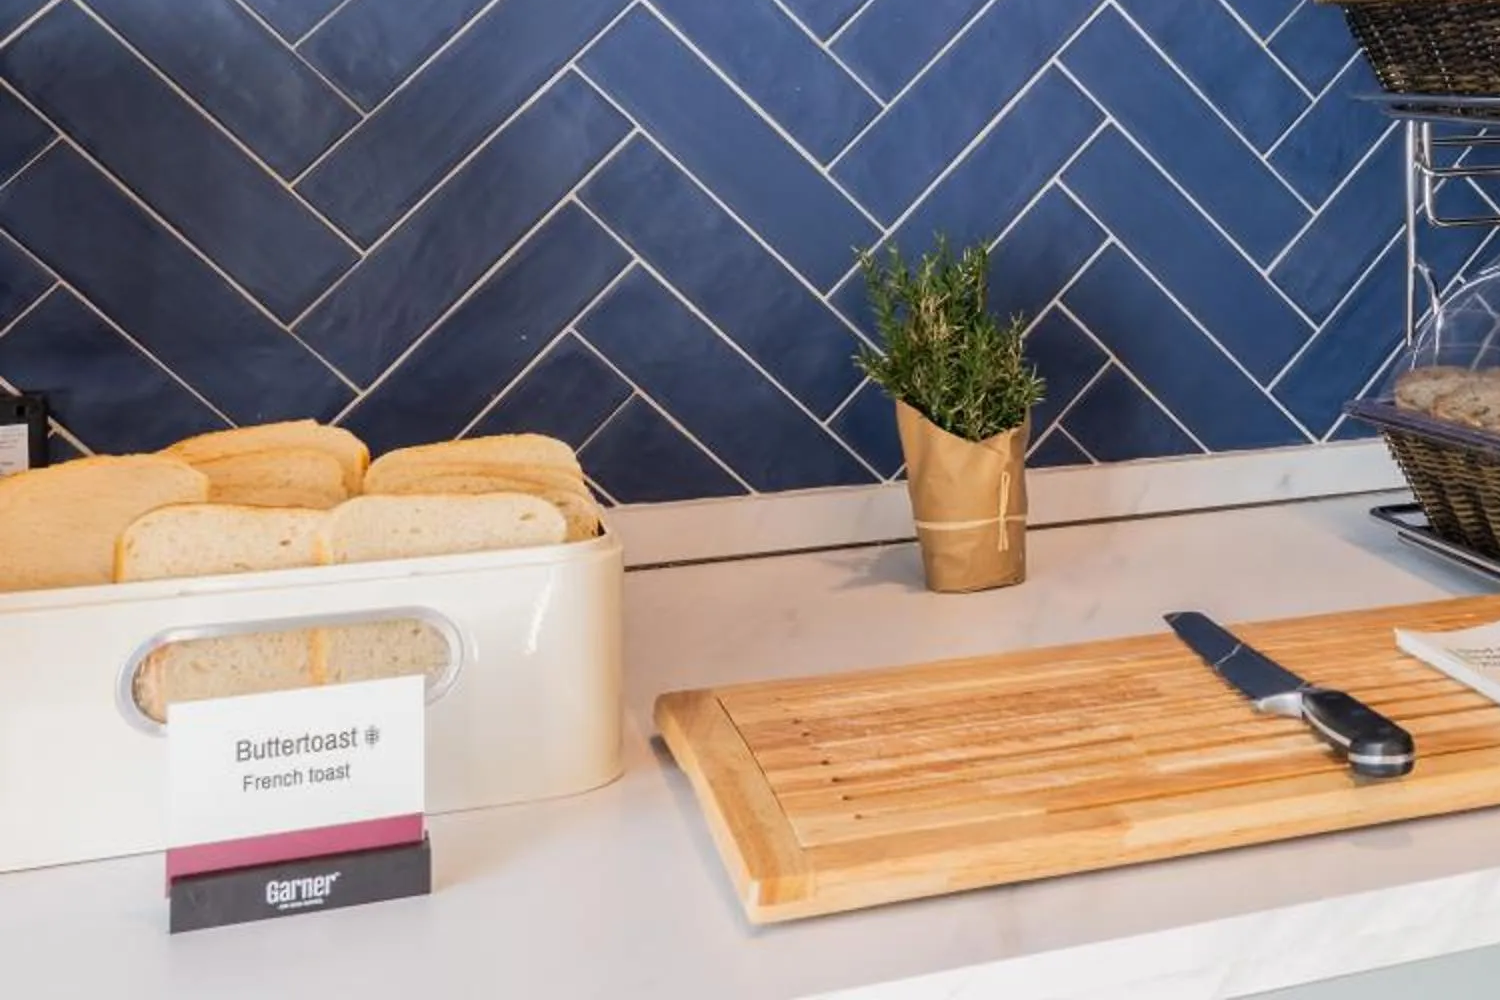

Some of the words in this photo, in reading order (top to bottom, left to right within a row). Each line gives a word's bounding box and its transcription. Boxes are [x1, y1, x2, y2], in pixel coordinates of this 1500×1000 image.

[235, 726, 359, 763] Buttertoast
[242, 766, 303, 793] French
[308, 762, 351, 785] toast
[265, 873, 338, 905] Garner
